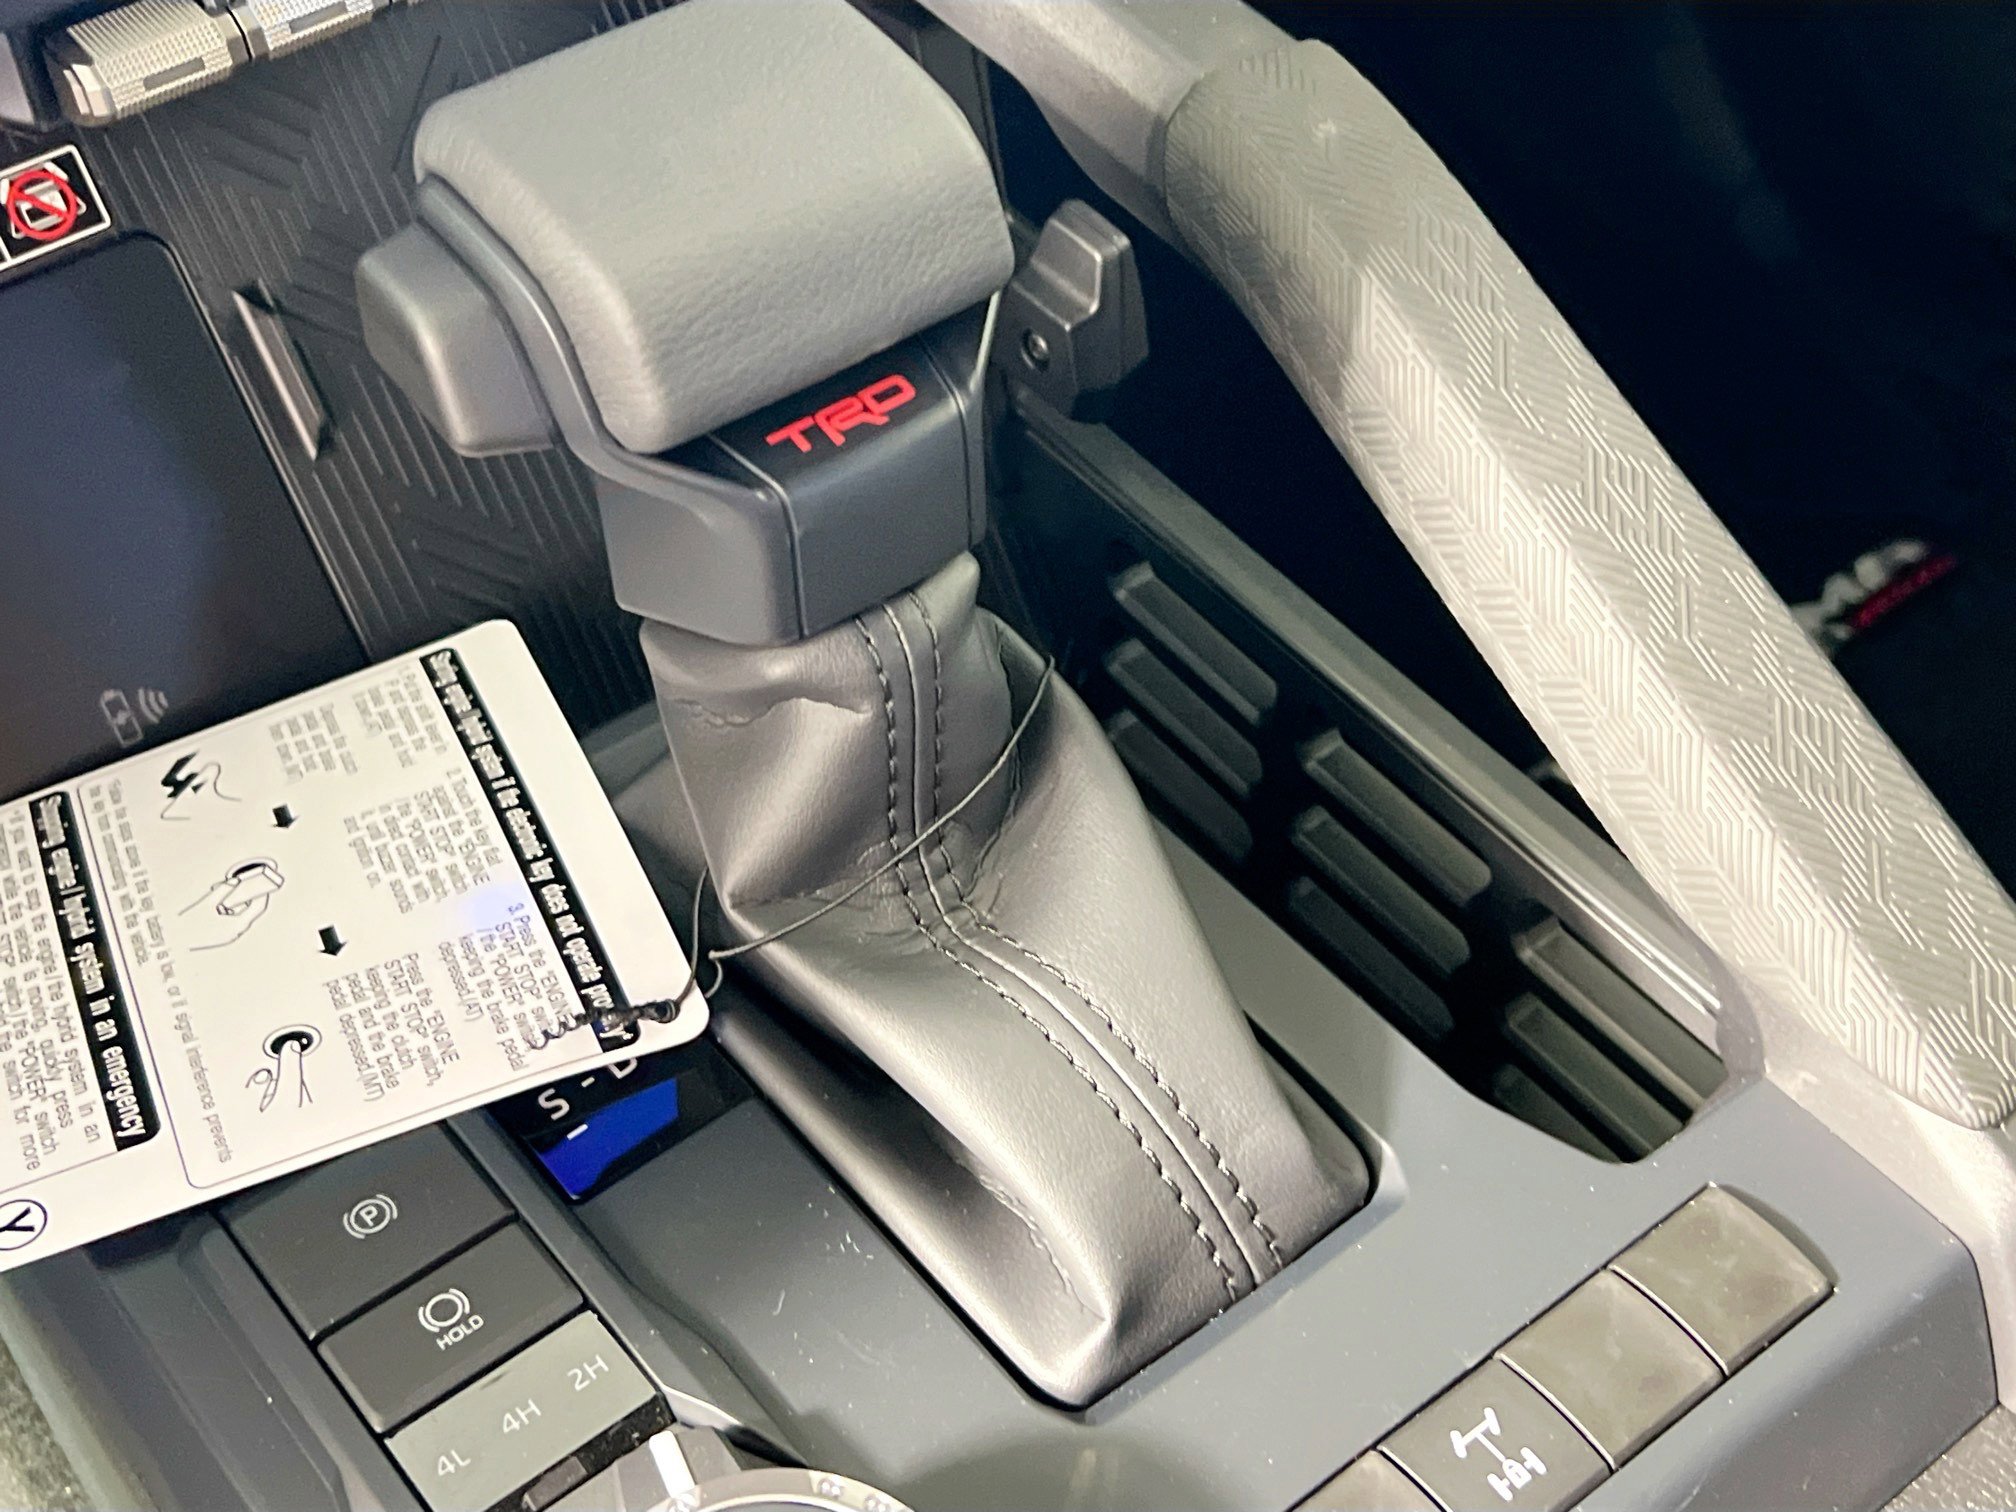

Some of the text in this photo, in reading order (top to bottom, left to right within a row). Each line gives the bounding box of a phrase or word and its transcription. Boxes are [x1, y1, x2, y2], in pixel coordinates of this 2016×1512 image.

[765, 374, 917, 453] TRD
[470, 742, 506, 780] system
[495, 786, 521, 809] the
[504, 806, 548, 860] electronic
[527, 856, 555, 883] key
[539, 882, 570, 915] does
[493, 920, 525, 958] START
[512, 913, 537, 947] Press
[527, 947, 547, 969] the
[554, 912, 585, 938] not
[489, 952, 525, 1006] "POWER"
[561, 936, 603, 983] operate
[320, 977, 352, 1011] pedal
[401, 951, 460, 1065] Press the "ENGINE
[457, 932, 530, 1072] keeping the brake pedal
[49, 1002, 78, 1044] hybrid
[172, 1011, 199, 1044] signal
[341, 971, 401, 1089] pedal and the brake
[364, 964, 418, 1070] keeping the clutch
[382, 958, 445, 1087] START STOP" switch,
[68, 940, 105, 995] system
[101, 1045, 146, 1137] emergency
[2, 1058, 26, 1101] switch
[35, 1037, 64, 1082] quickly
[50, 1088, 74, 1129] press
[56, 1046, 88, 1096] system
[184, 1045, 216, 1111] interference
[12, 1104, 32, 1125] for
[17, 1039, 48, 1103] "POWER"
[33, 1110, 60, 1156] switch
[537, 1088, 570, 1121] S
[19, 1132, 41, 1171] more
[201, 1112, 234, 1164] prevents
[0, 1206, 35, 1232] Y
[359, 1205, 378, 1227] P
[436, 1314, 484, 1351] HOLD
[567, 1354, 609, 1391] 2H
[502, 1398, 542, 1434] 4H
[437, 1449, 472, 1477] 4L
